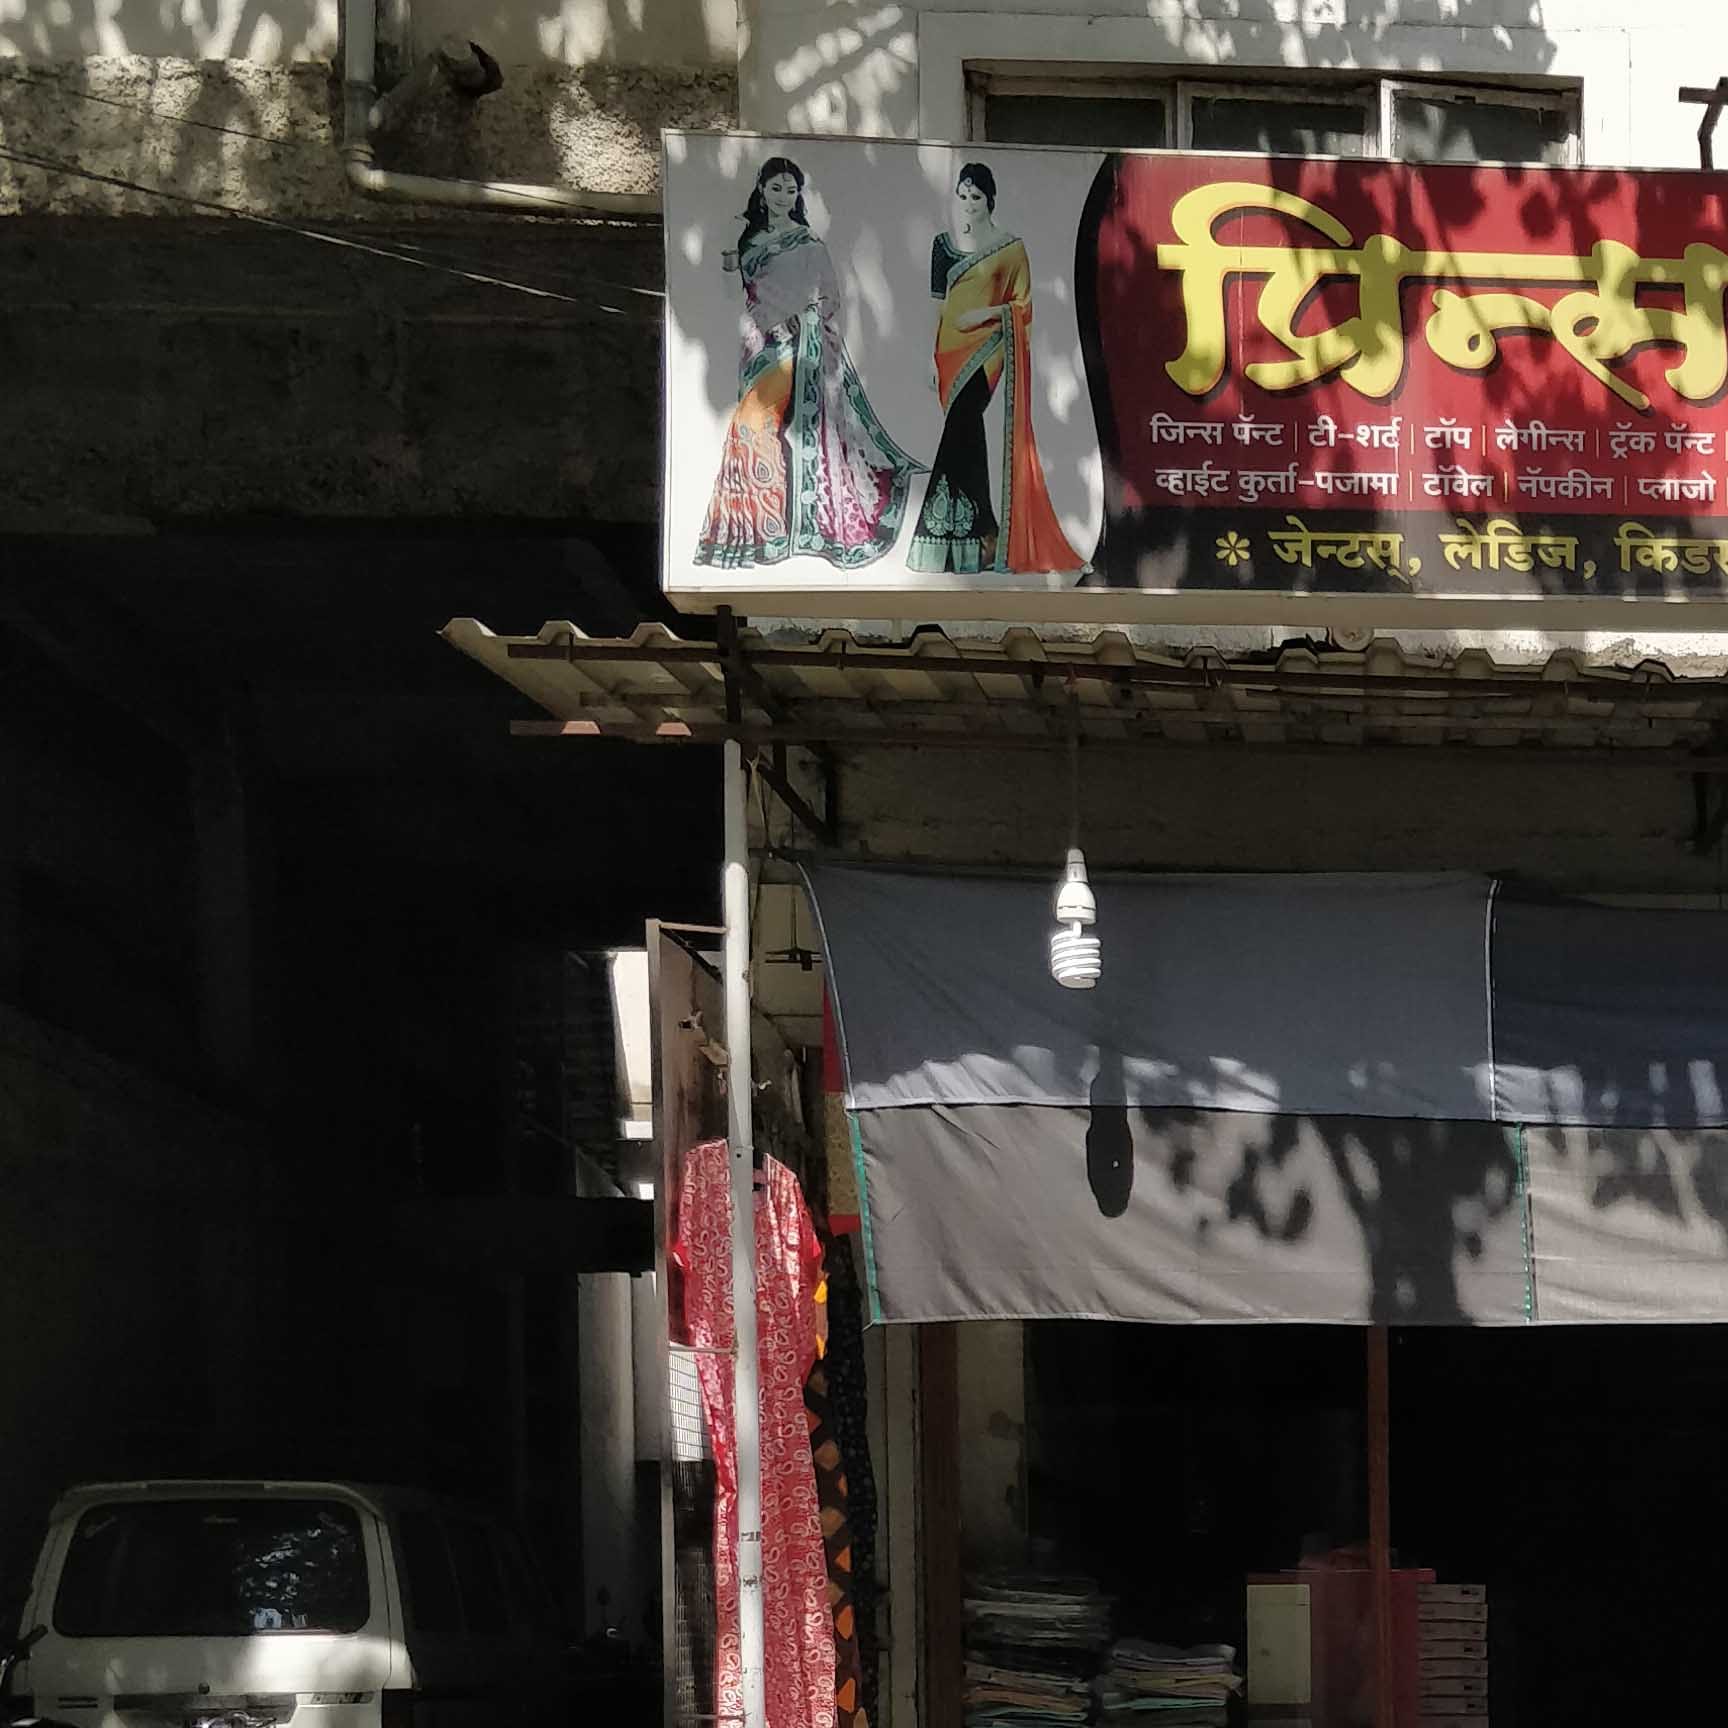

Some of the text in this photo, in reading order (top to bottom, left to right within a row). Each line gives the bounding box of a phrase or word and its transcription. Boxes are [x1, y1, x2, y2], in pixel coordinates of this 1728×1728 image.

[1150, 412, 1224, 445] जिन्स
[1232, 413, 1283, 446] पॅन्ट
[1308, 415, 1402, 448] टी-शर्ट
[1424, 417, 1472, 449] टॉप
[1495, 419, 1585, 451] लेगीन्स
[1609, 422, 1656, 459] ट्रॅक
[1664, 423, 1715, 454] पॅन्ट
[1156, 460, 1230, 496] व्हाईट
[1238, 462, 1399, 502] कुर्ता-पजामा
[1422, 465, 1493, 497] टॉवेल
[1518, 467, 1613, 499] नॅपकीन
[1638, 471, 1716, 501] प्लाजो
[1438, 518, 1600, 580] लेडिज,
